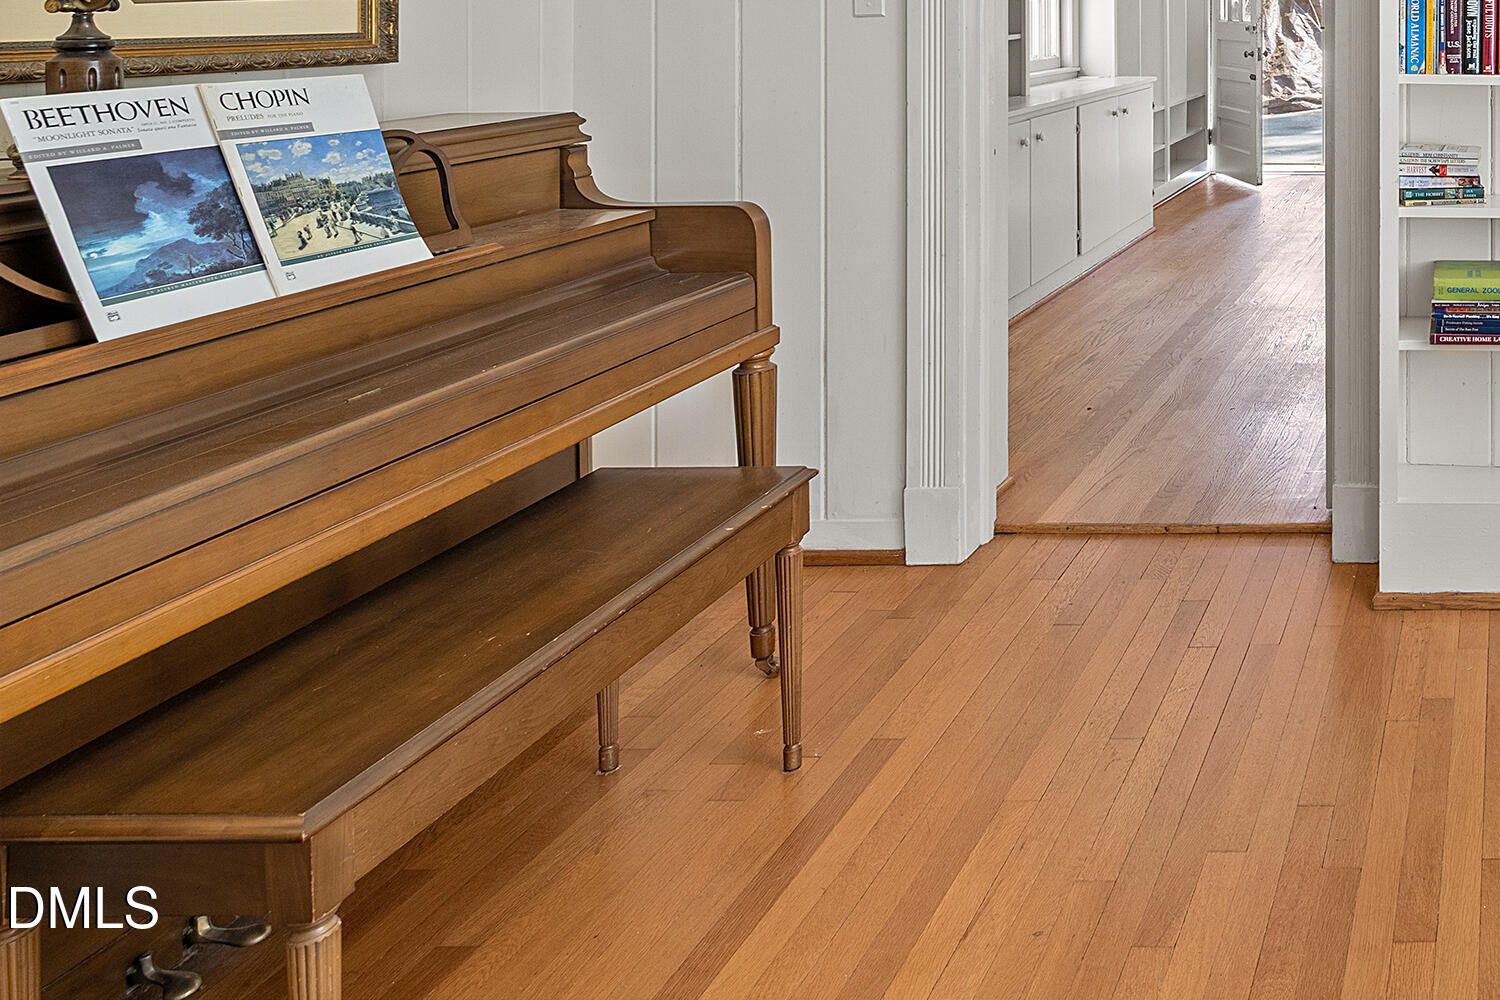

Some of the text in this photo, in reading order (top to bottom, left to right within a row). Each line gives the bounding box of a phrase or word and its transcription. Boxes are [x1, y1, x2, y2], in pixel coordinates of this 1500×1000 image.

[1485, 13, 1493, 39] IDIOTS
[1410, 23, 1419, 63] ALMANAC
[219, 87, 311, 111] CHOPIN
[22, 96, 191, 130] BEETHOVEN
[226, 113, 265, 123] PRELUDES
[27, 151, 57, 160] EDITED
[69, 146, 102, 156] WILLARD
